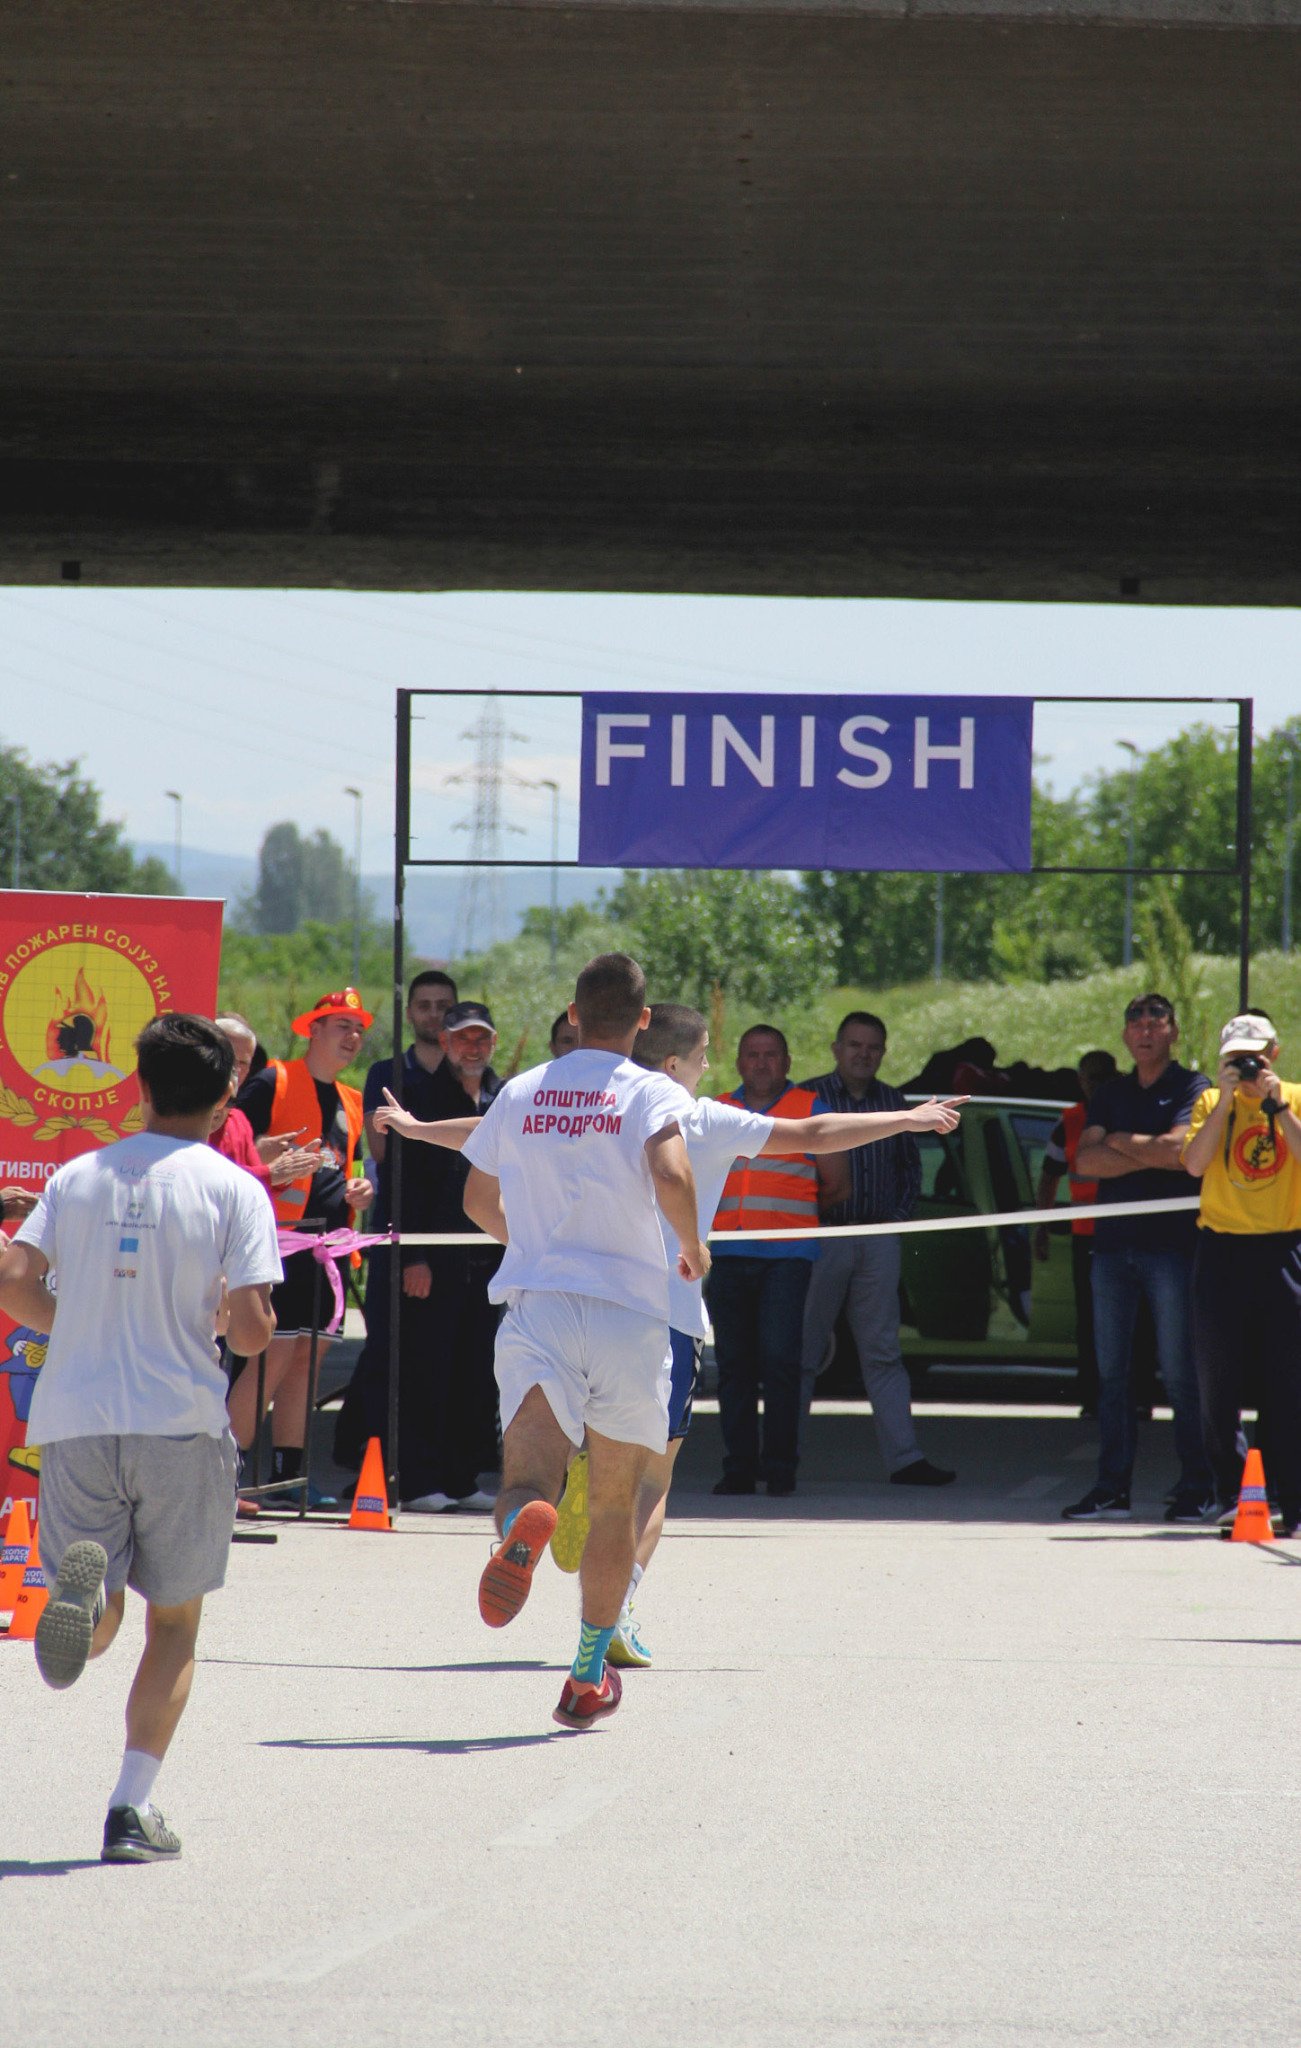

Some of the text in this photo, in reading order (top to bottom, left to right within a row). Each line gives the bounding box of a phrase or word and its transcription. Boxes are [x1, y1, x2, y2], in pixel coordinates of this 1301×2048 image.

[594, 713, 976, 790] FINISH
[5, 924, 98, 969] ПОЖАРЕН
[103, 928, 159, 973] СОЈУЗ
[152, 975, 172, 1003] НА
[34, 1087, 120, 1114] СКОПЈЕ
[533, 1089, 617, 1108] ОПШТИНА
[522, 1113, 622, 1138] АЕРОДРОМ
[0, 1160, 62, 1179] ТИВПО
